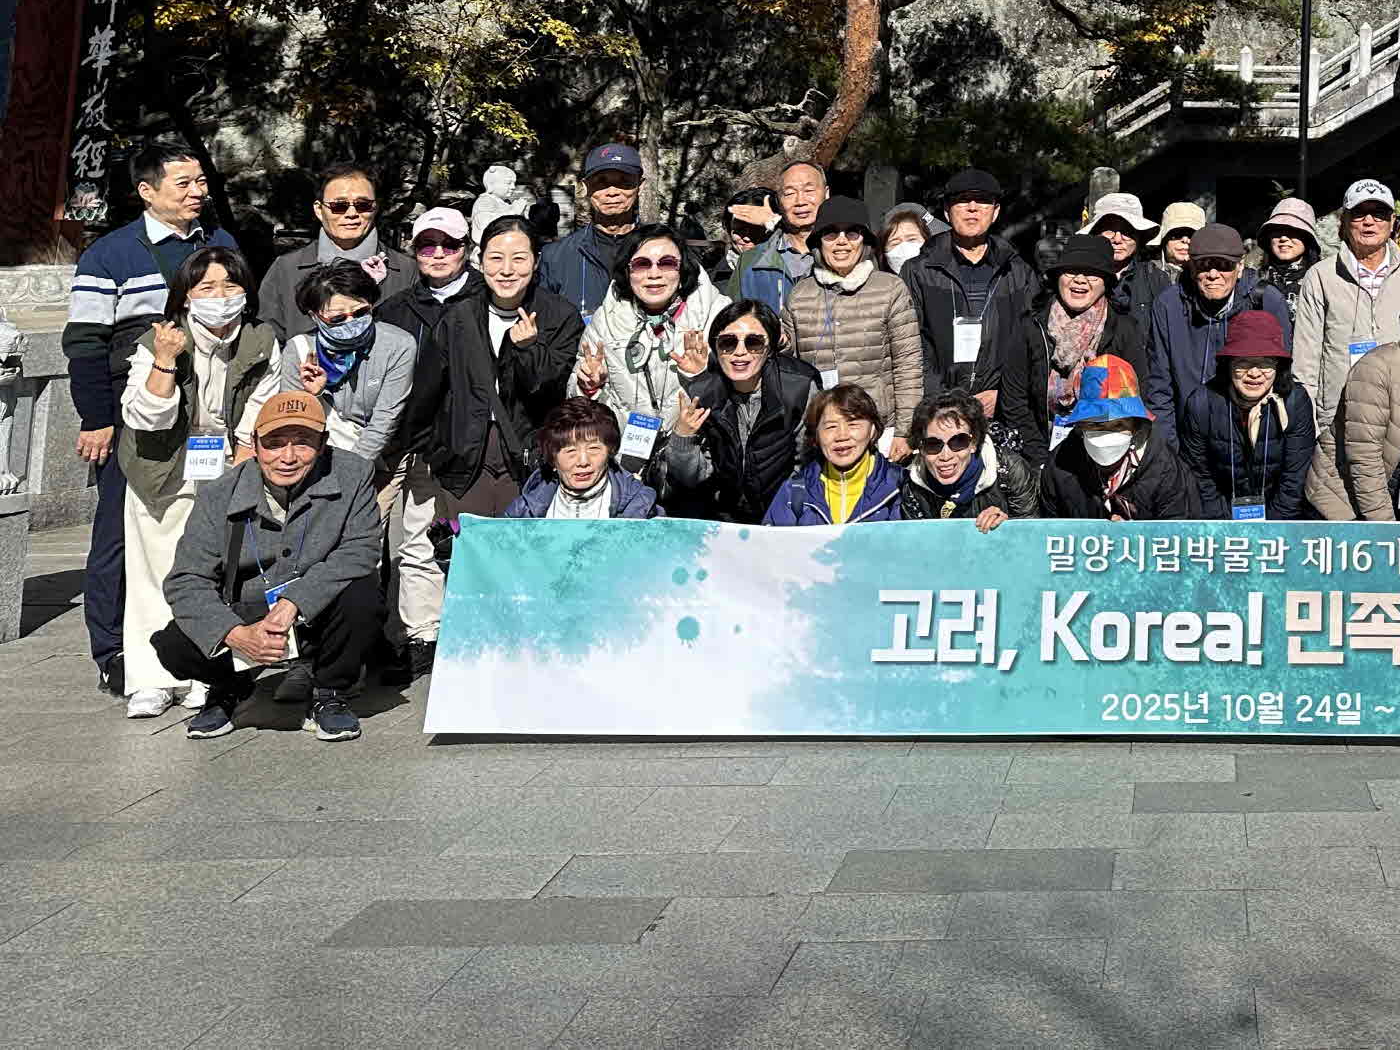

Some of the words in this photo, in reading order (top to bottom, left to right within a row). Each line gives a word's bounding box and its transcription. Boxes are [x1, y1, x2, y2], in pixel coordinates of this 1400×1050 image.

[278, 399, 308, 413] UNIV
[1045, 534, 1290, 574] 밀양시립박물관
[870, 588, 1018, 671] 고려,
[1039, 590, 1264, 666] Korea!
[1101, 693, 1210, 725] 2025년
[1221, 693, 1285, 726] 10월
[1294, 693, 1363, 726] 24일
